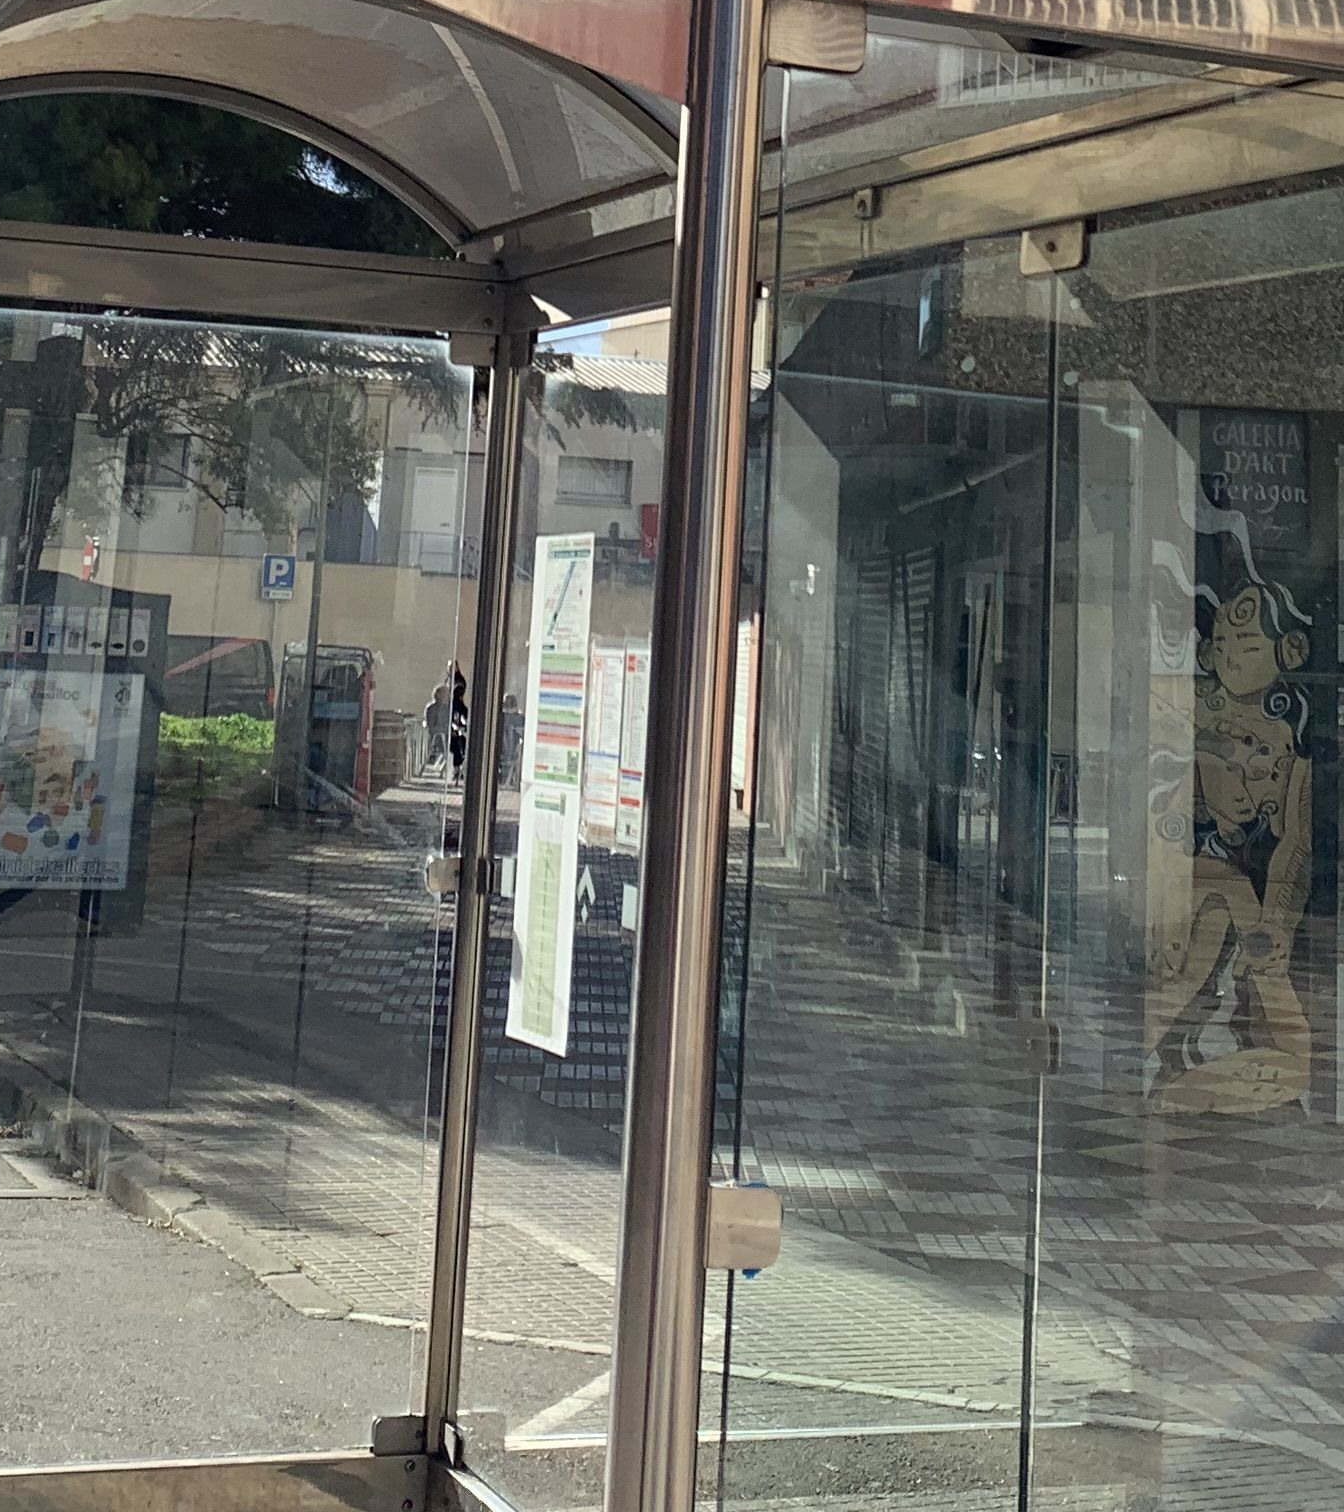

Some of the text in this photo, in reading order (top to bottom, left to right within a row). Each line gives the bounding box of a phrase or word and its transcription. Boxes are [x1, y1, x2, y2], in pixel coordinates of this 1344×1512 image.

[1213, 422, 1300, 450] GALERIA
[1224, 450, 1295, 475] D'ART
[1212, 472, 1308, 514] Peragon
[269, 558, 290, 585] P
